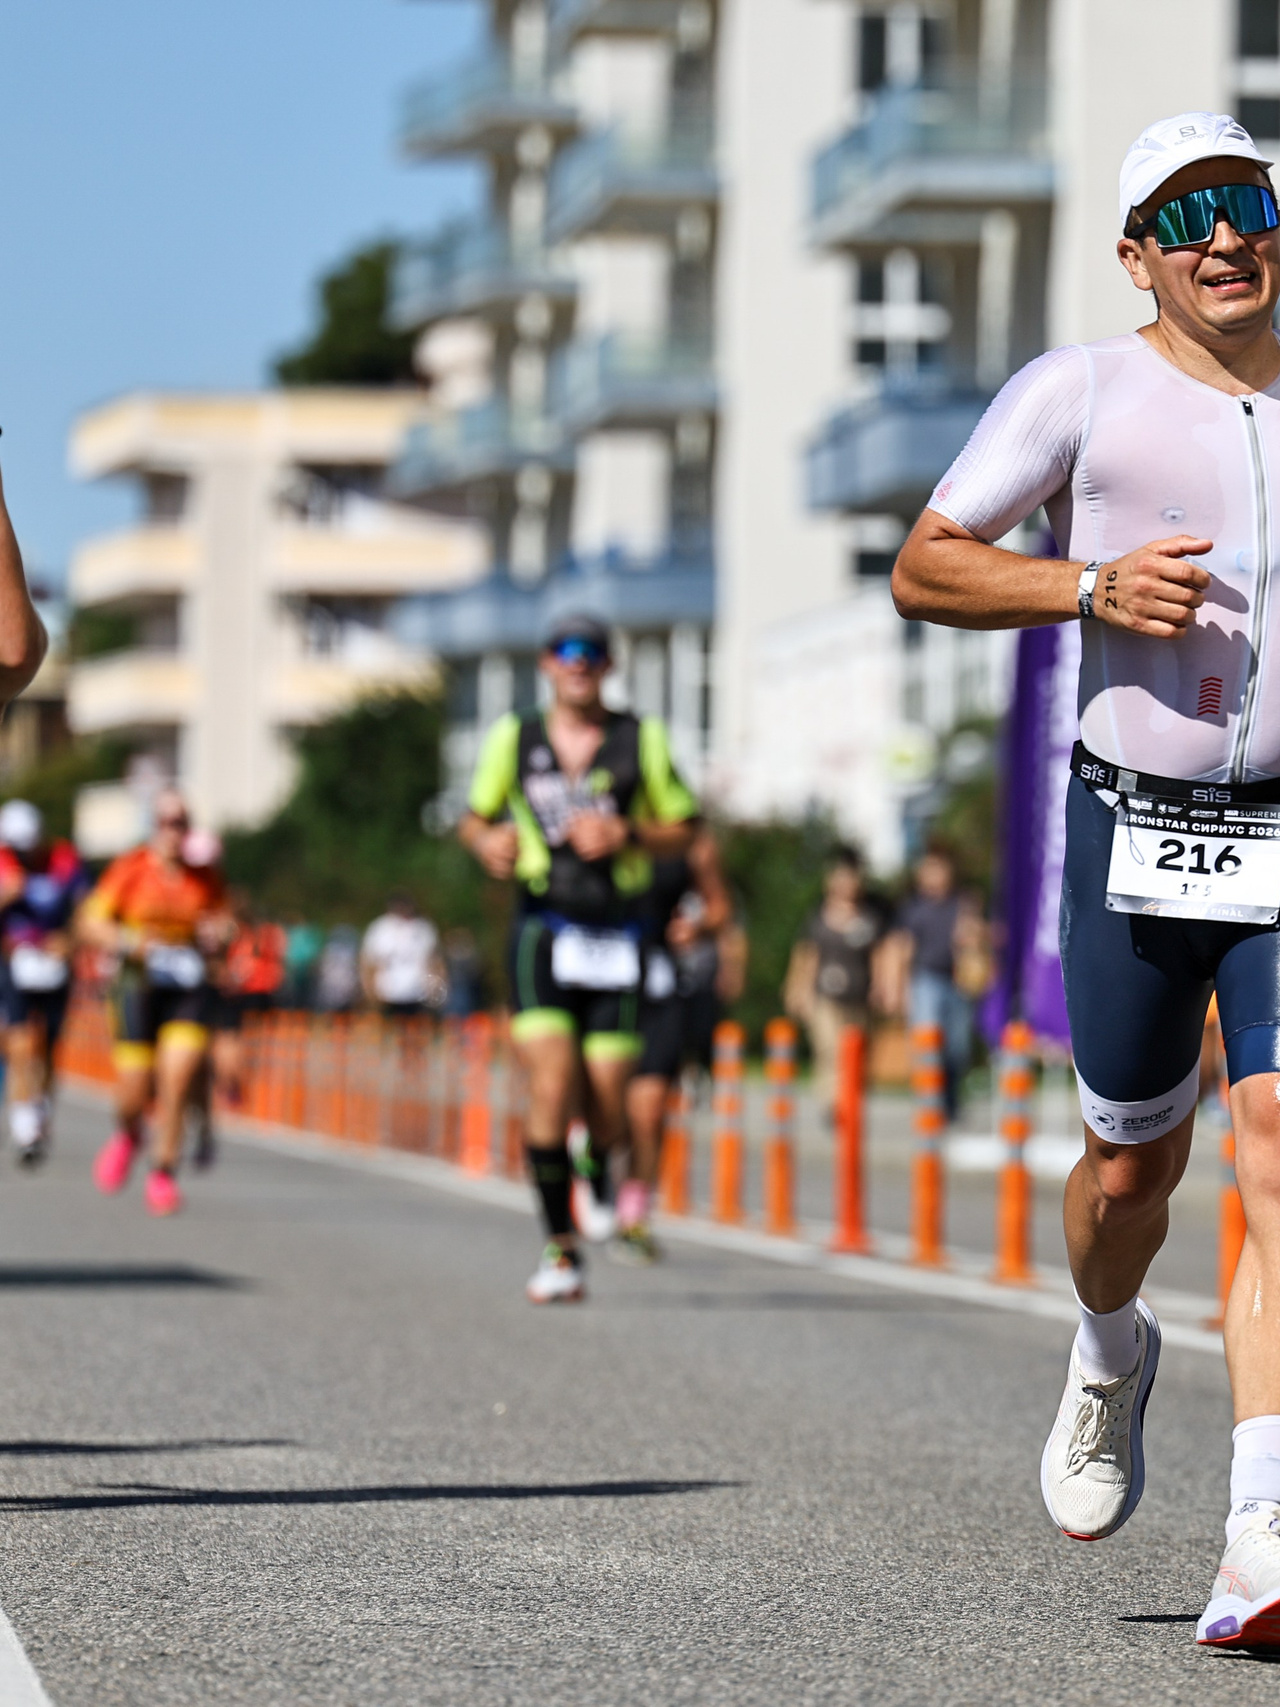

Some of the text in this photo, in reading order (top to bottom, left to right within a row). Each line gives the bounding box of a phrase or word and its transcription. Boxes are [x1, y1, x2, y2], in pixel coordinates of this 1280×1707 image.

[1105, 570, 1118, 610] 216
[1125, 812, 1188, 831] IRONSTAR
[1191, 822, 1246, 836] СИРИУС
[1156, 838, 1243, 877] 216
[1121, 1110, 1167, 1126] ZEROD
